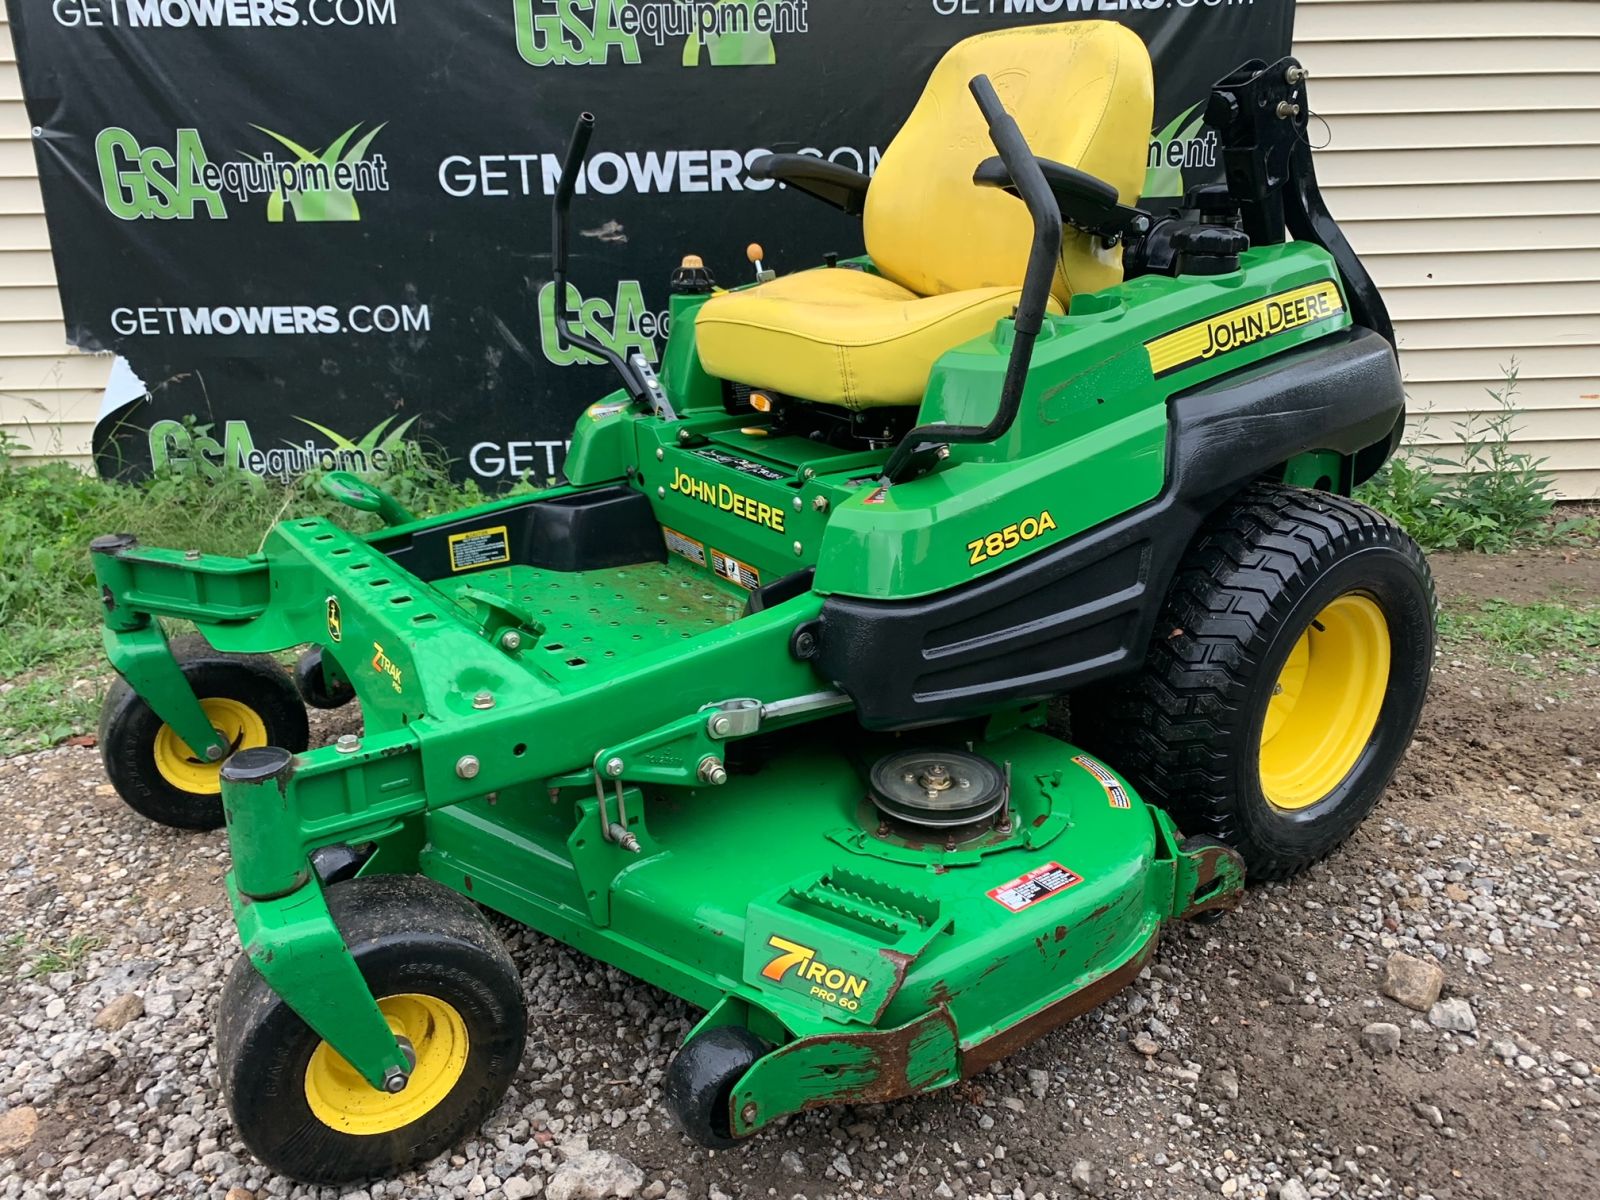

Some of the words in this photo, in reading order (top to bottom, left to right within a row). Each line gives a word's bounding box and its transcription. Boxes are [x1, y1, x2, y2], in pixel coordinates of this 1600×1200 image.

[53, 0, 398, 28] GETMOWERS.COM
[620, 0, 808, 45] equipment
[202, 152, 390, 202] equipment
[110, 304, 431, 336] GETMOWERS.COM
[1201, 312, 1263, 355] JOHN
[1266, 291, 1331, 329] DEERE
[669, 466, 717, 507] JOHN
[718, 481, 786, 533] DEERE
[966, 510, 1058, 567] Z850A
[810, 986, 837, 1003] PRO
[838, 997, 858, 1011] 60
